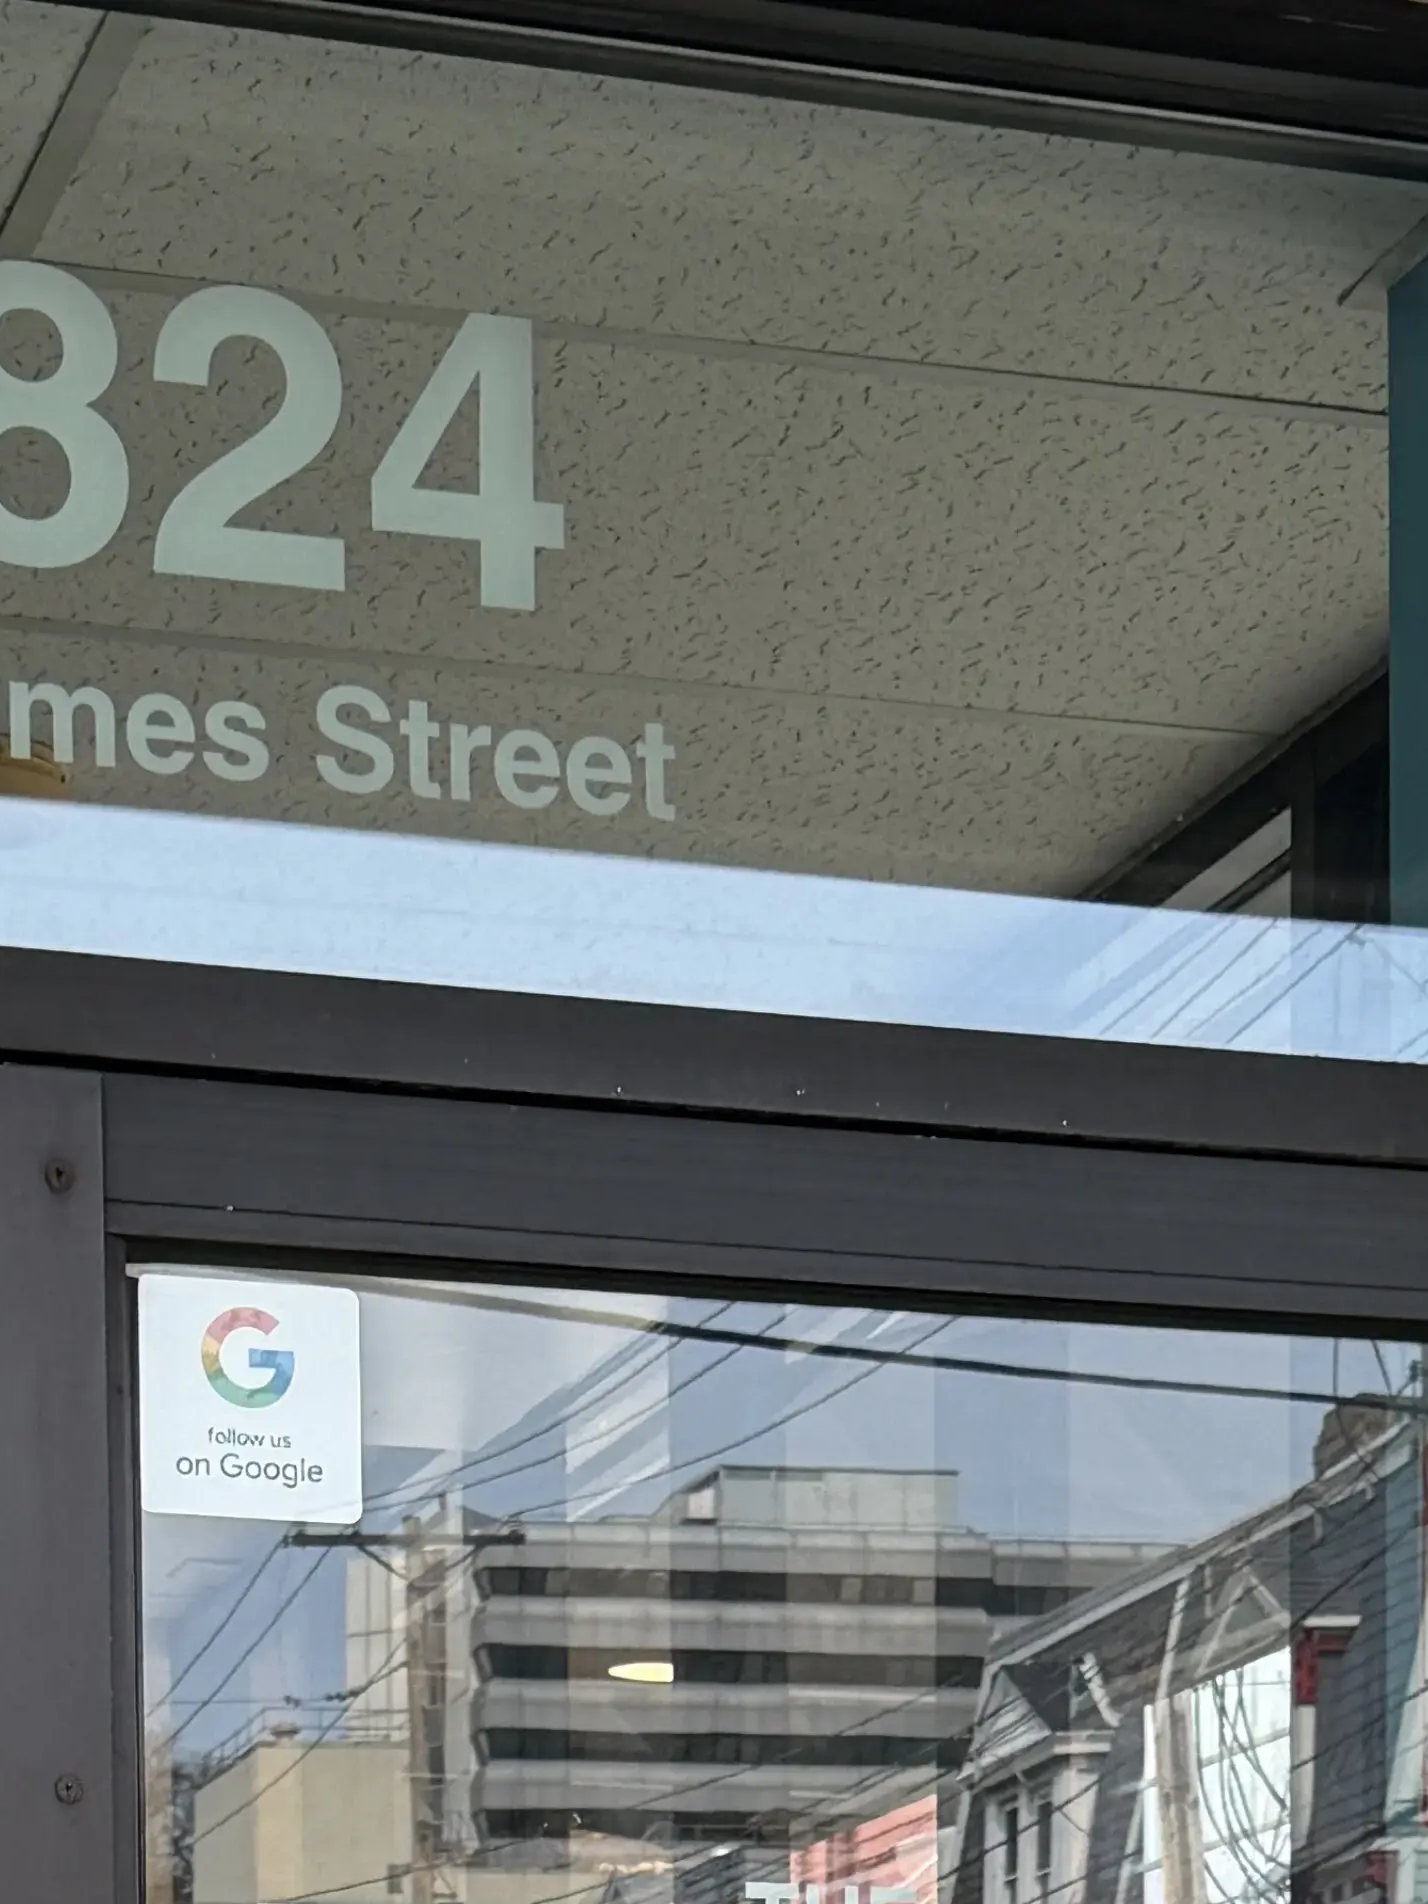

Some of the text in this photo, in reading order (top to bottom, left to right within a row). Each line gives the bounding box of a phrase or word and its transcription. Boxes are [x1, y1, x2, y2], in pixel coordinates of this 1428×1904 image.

[316, 684, 677, 822] Street
[208, 1427, 292, 1448] follow us
[176, 1453, 323, 1488] on Google
